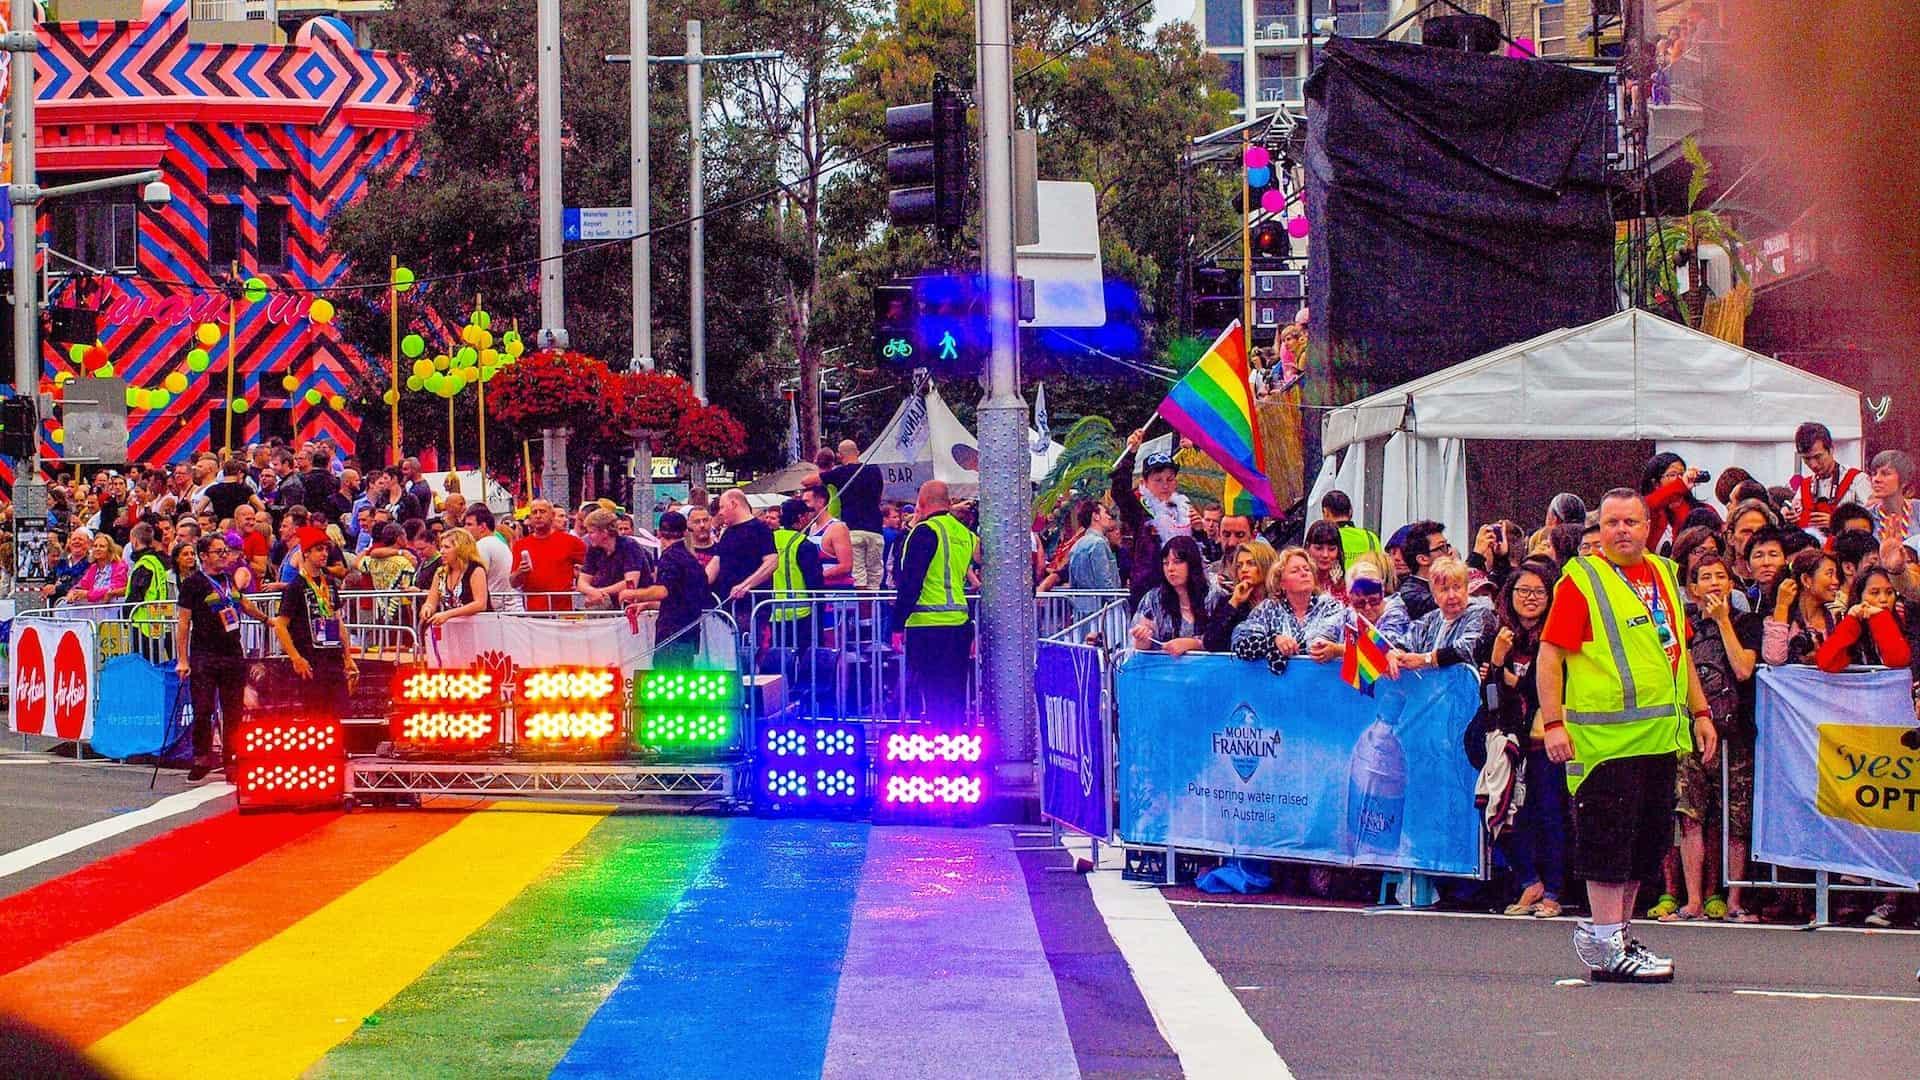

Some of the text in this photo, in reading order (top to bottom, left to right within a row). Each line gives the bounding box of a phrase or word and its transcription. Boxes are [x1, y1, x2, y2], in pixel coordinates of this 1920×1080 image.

[888, 468, 913, 483] BAR
[1225, 728, 1263, 739] MOUNT
[1212, 733, 1277, 758] FRANKLIN
[1188, 783, 1308, 806] Pure spring water raised
[1221, 807, 1276, 823] in Australia
